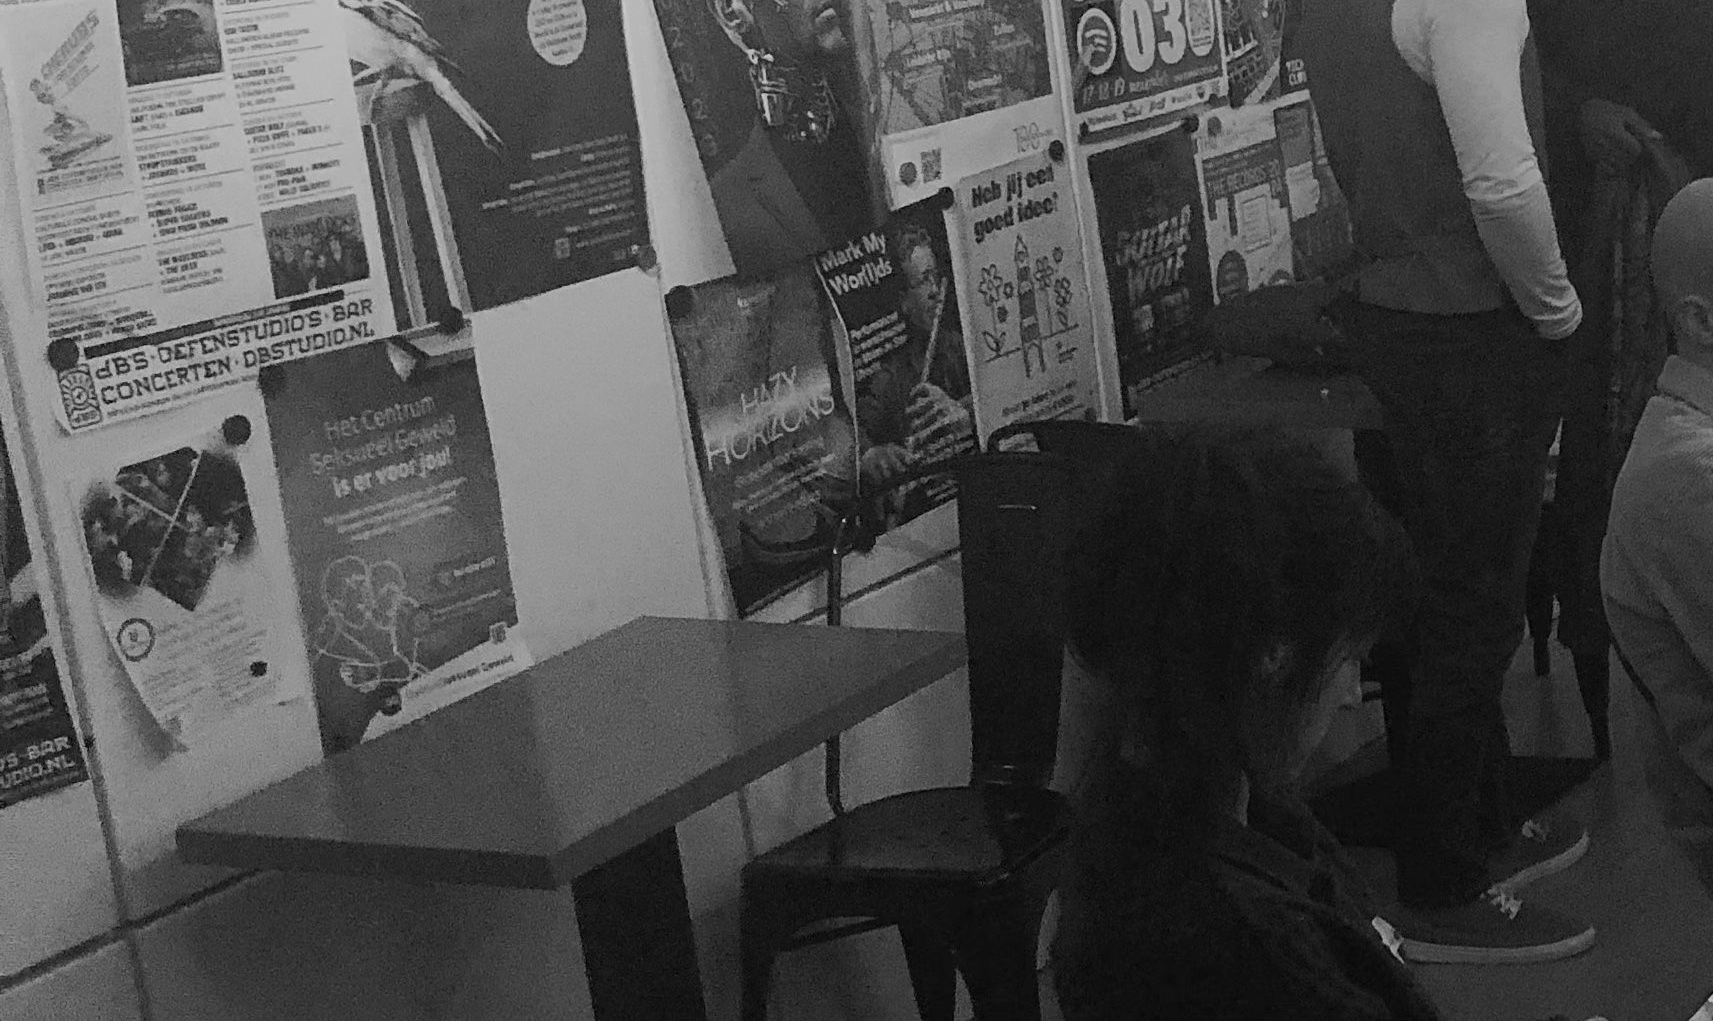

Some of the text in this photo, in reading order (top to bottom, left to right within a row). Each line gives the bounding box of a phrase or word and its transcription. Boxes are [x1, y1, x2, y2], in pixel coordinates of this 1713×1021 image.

[971, 180, 1002, 209] Heb
[973, 205, 1015, 245] goed
[820, 231, 888, 273] Mark My
[332, 298, 374, 323] BAR
[100, 358, 233, 405] CONCERTEN
[242, 321, 376, 369] DBSTUDIO.NL
[740, 365, 798, 414] HAZY
[702, 394, 835, 472] HORIZONS
